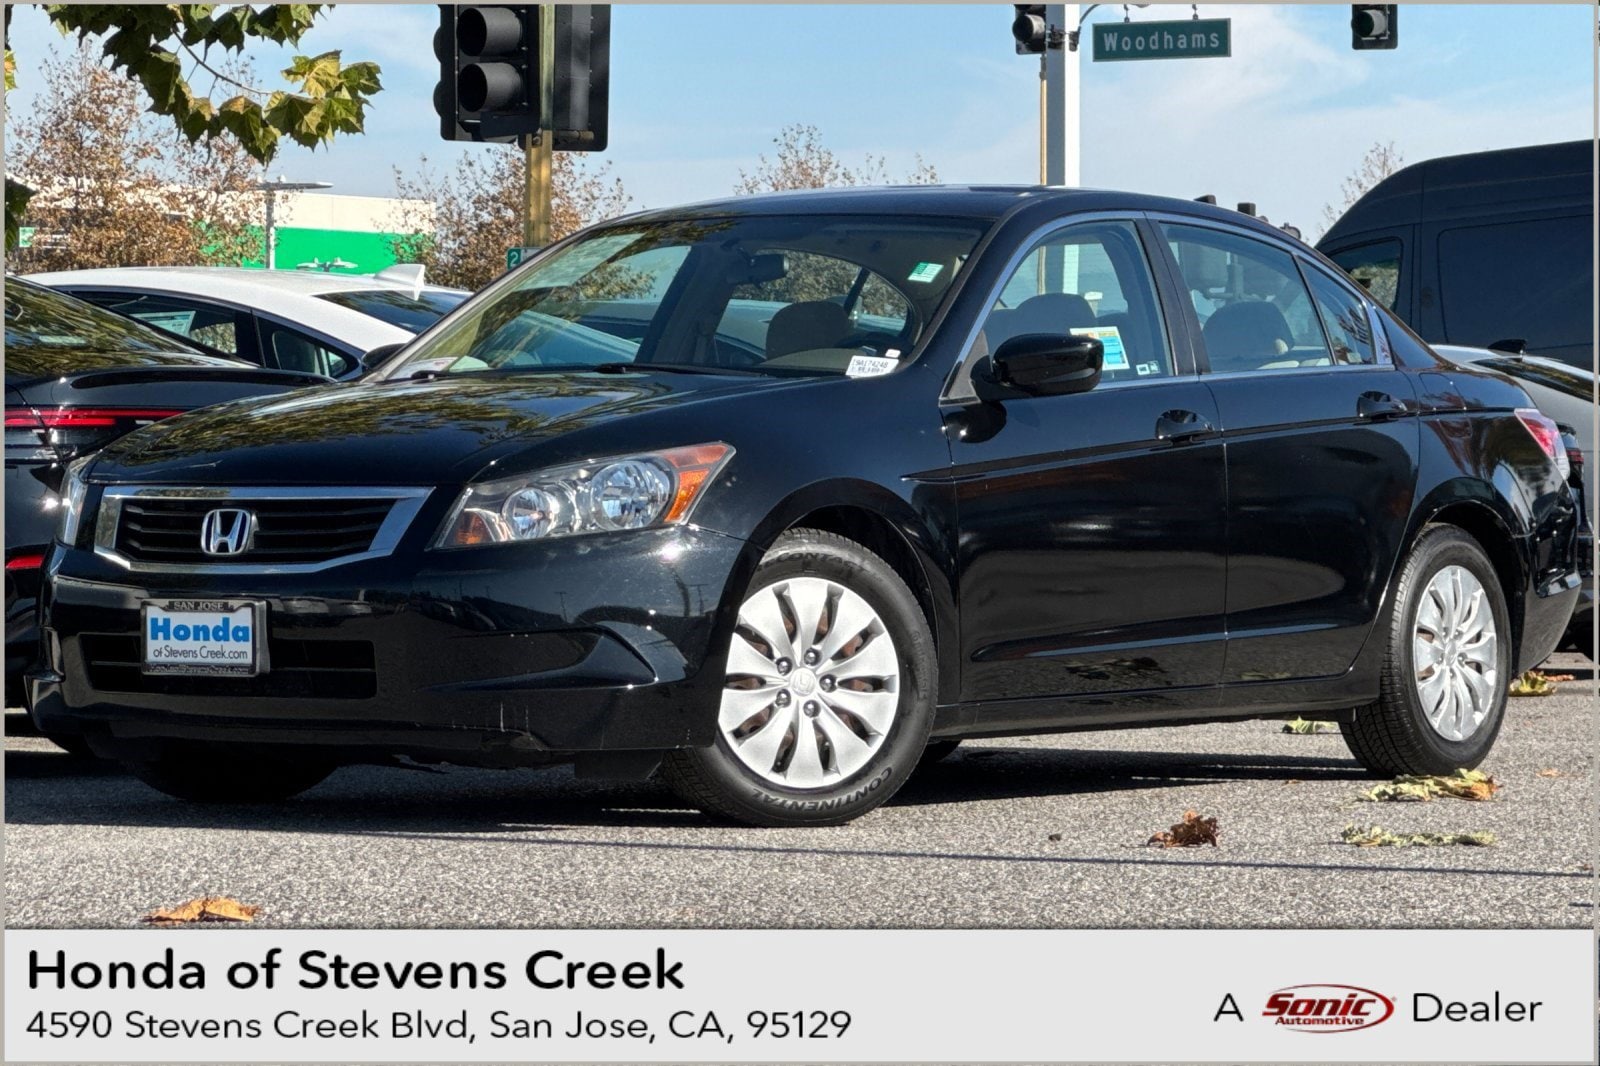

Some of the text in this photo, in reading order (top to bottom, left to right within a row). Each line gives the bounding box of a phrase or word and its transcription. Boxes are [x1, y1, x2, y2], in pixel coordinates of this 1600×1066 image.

[1103, 31, 1220, 52] Woodhams
[173, 601, 225, 611] SAN JOSE
[150, 617, 250, 642] Honda
[153, 644, 248, 660] of Stevens Creek.com
[753, 767, 893, 812] CONTINENTAL
